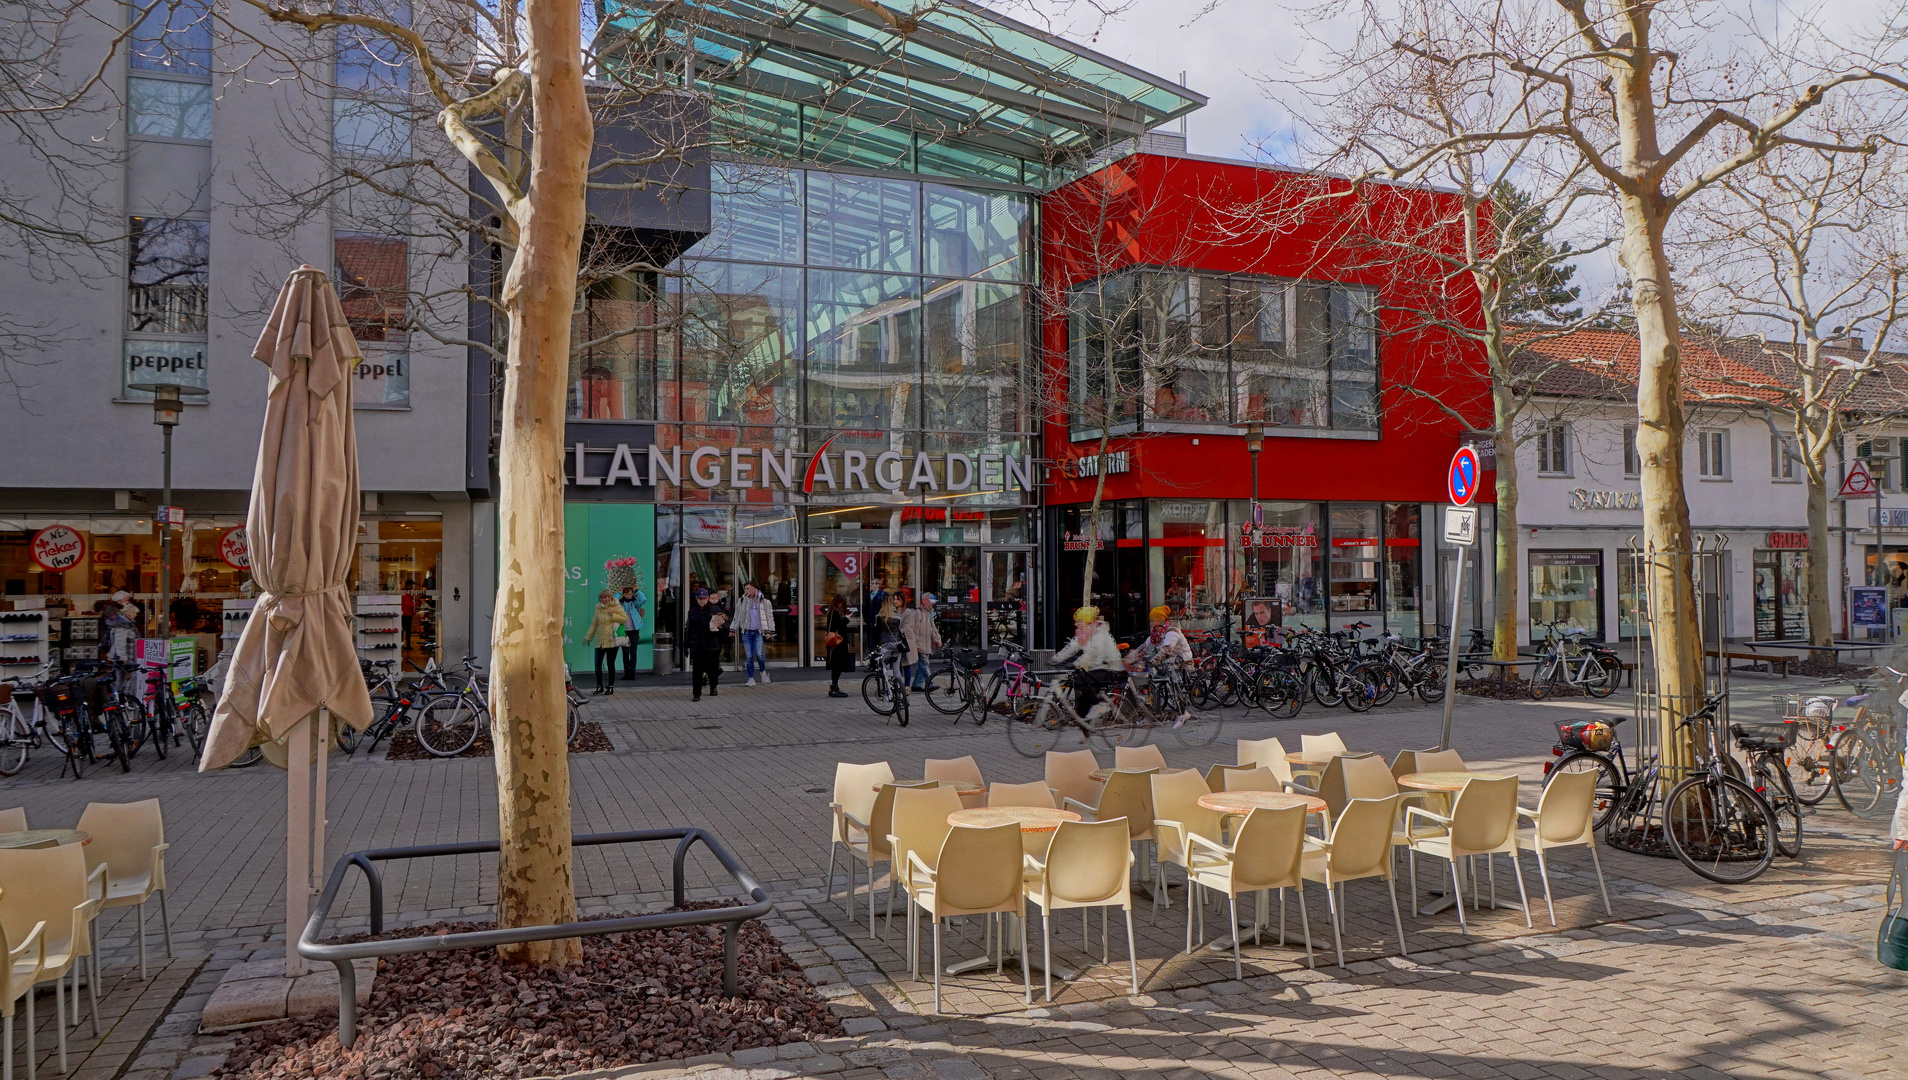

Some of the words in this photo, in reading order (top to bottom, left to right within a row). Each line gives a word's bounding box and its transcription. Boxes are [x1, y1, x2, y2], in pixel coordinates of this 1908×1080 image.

[130, 351, 205, 373] peppel
[564, 442, 792, 489] LANGEN
[804, 441, 1033, 493] ARCADEN
[1079, 452, 1126, 478] SATRN
[38, 540, 79, 560] rieker
[1241, 534, 1317, 548] BUNNER
[844, 556, 858, 574] 3
